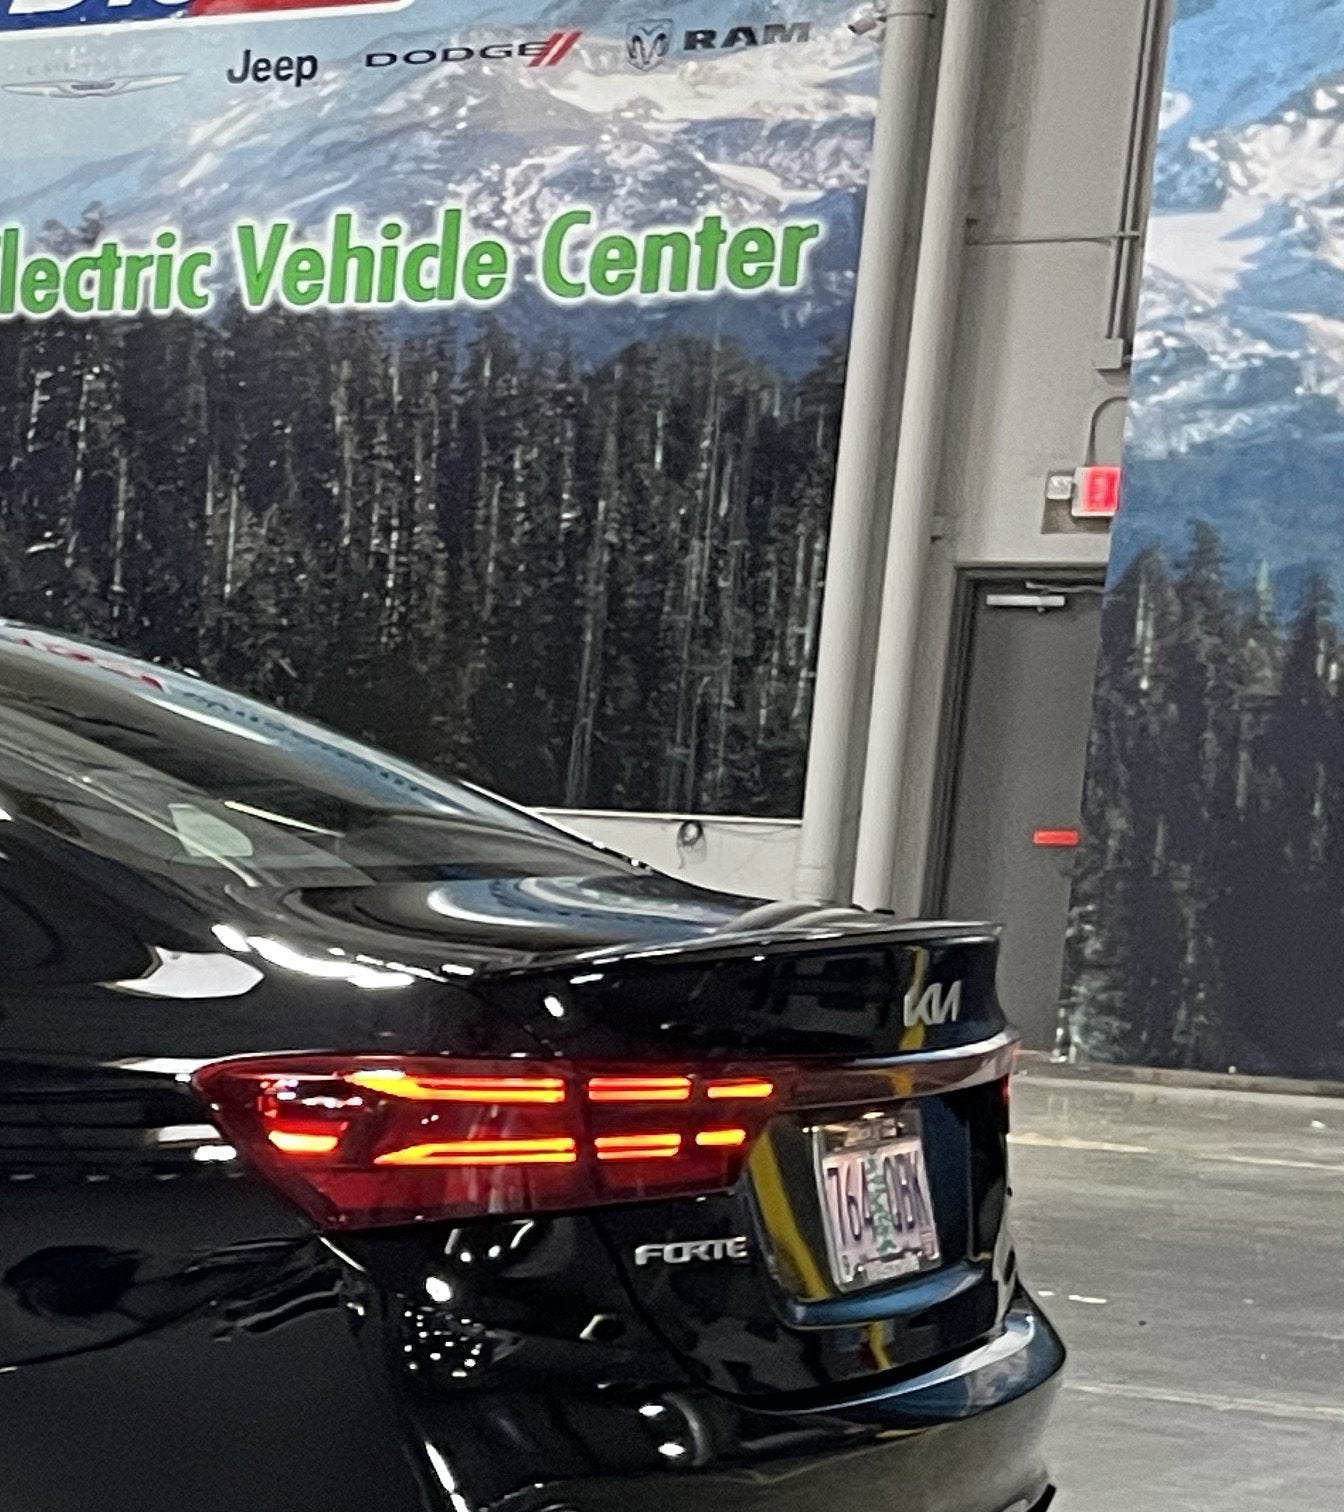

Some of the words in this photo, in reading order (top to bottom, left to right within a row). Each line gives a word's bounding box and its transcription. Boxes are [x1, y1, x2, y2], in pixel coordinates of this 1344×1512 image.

[683, 22, 811, 51] RAM
[226, 48, 318, 86] Jeep
[364, 40, 550, 68] DODGE
[234, 208, 508, 307] Vehicle
[541, 209, 820, 299] Center
[635, 1237, 747, 1265] FORTE
